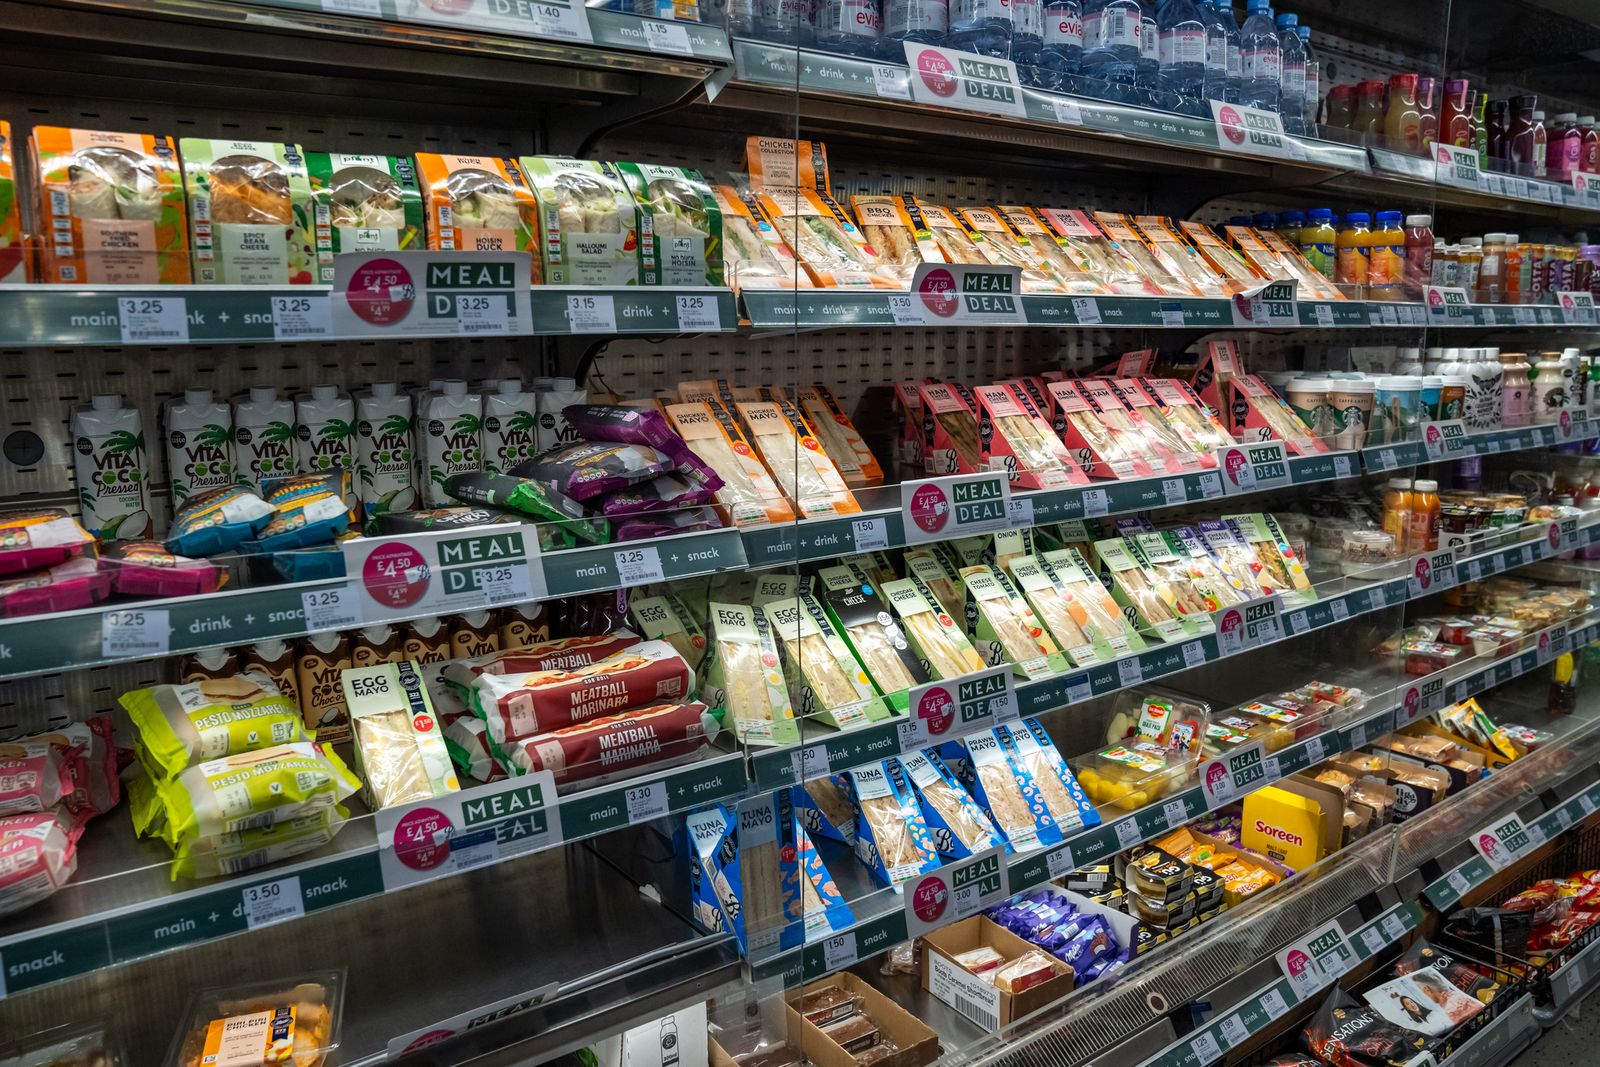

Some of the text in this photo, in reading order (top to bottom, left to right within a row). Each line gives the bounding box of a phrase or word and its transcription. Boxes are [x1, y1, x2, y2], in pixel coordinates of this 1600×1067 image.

[537, 7, 560, 18] 1.40
[648, 23, 667, 34] 1.15
[771, 61, 845, 80] main drink
[963, 64, 1009, 83] MEAL
[969, 83, 1014, 102] DEAL
[1133, 119, 1206, 138] main drink snack
[1246, 112, 1277, 130] MEAL
[759, 140, 794, 150] CHICKEN
[1251, 131, 1281, 147] DEAL
[760, 148, 795, 157] COLLECTION
[1455, 153, 1475, 167] MEAL
[867, 207, 891, 217] BBQ
[1012, 215, 1031, 224] BBQ
[476, 237, 503, 245] HOISIN
[477, 243, 503, 251] DUCK
[433, 265, 512, 286] MEAL
[966, 276, 1012, 293] MEAL
[1263, 285, 1292, 300] MEAL
[971, 297, 1015, 314] DEAL
[1445, 292, 1465, 305] MEAL
[71, 311, 118, 327] main
[622, 305, 654, 319] drink
[774, 305, 892, 317] main drink snack
[1041, 307, 1060, 317] main
[1104, 307, 1123, 318] snack
[1204, 310, 1220, 319] snack
[927, 388, 949, 397] HAM
[984, 391, 1006, 400] HAM
[1055, 389, 1075, 398] HAM
[1092, 390, 1110, 399] HAM
[677, 412, 707, 420] CHICKEN
[747, 408, 776, 416] CHICKEN
[750, 412, 779, 421] MAYO
[679, 416, 710, 425] MAYO
[498, 429, 532, 446] VITA
[1442, 425, 1463, 438] MEAL
[310, 438, 347, 456] VITA
[370, 433, 407, 450] VITA
[443, 432, 478, 449] VITA
[185, 444, 225, 462] VITA
[251, 441, 290, 459] VITA
[370, 449, 411, 464] COCO
[442, 448, 482, 463] COCO
[497, 444, 536, 459] COCO
[1250, 448, 1281, 463] MEAL
[92, 451, 136, 470] VITA
[185, 461, 230, 476] COCO
[251, 458, 294, 474] COCO
[309, 454, 353, 470] COCO
[374, 460, 409, 475] Pressed
[92, 468, 140, 484] COCO
[1256, 464, 1285, 480] DEAL
[189, 473, 230, 491] Pressed
[97, 482, 140, 500] Pressed
[955, 481, 1001, 500] MEAL
[1141, 491, 1158, 501] main
[960, 502, 1004, 522] DEAL
[1032, 500, 1081, 516] main drink
[442, 535, 521, 563] MEAL
[766, 533, 839, 554] main drink
[576, 547, 720, 577] main snack
[1050, 558, 1069, 568] CHEESE
[1149, 551, 1170, 559] SALAD
[1432, 554, 1452, 568] MEAL
[1015, 565, 1036, 575] CHEESE
[1018, 570, 1040, 579] ONION
[1054, 562, 1074, 571] ONION
[760, 582, 787, 592] EGG
[843, 594, 866, 607] CHEESE
[893, 592, 918, 602] CHEESE
[640, 606, 664, 619] EGG
[644, 612, 668, 624] MAYO
[718, 609, 745, 621] EGG
[774, 607, 798, 619] EGG
[778, 614, 804, 625] CRESS
[1246, 602, 1275, 622] MEAL
[189, 615, 232, 634] drink
[720, 617, 747, 627] MAYO
[466, 641, 496, 657] VITA
[541, 653, 593, 672] MEATBALL
[1165, 656, 1181, 668] drink
[352, 675, 387, 691] EGG
[960, 680, 1006, 701] MEAL
[1033, 673, 1113, 705] main snack
[1422, 678, 1443, 695] MEAL
[355, 684, 390, 699] MAYO
[571, 680, 629, 705] MEATBALL
[571, 694, 629, 721] MARINARA
[195, 712, 232, 731] PESTO
[599, 724, 658, 750] MEATBALL
[968, 736, 995, 748] PRAWN
[600, 739, 662, 766] MARINARA
[827, 736, 893, 764] drink snack
[970, 741, 997, 752] MAYO
[905, 756, 926, 769] TUNA
[1231, 752, 1260, 772] MEAL
[212, 771, 251, 790] PESTO
[855, 768, 882, 780] TUNA
[1235, 769, 1263, 787] DEAL
[467, 789, 541, 822] MEAL
[590, 776, 722, 823] main snack
[741, 805, 772, 821] TUNA
[692, 818, 724, 833] TUNA
[742, 813, 772, 831] MAYO
[1497, 820, 1521, 840] MEAL
[695, 825, 725, 841] MAYO
[1256, 819, 1303, 847] Soreen
[1506, 834, 1529, 852] DEAL
[1024, 839, 1105, 881] main snack
[955, 862, 998, 884] MEAL
[305, 877, 349, 899] snack
[9, 918, 197, 978] snack main
[1310, 929, 1340, 956] MEAL
[780, 930, 888, 980] main snack
[1064, 943, 1081, 961] Milka
[226, 1022, 267, 1031] CHICKEN
[1243, 1011, 1258, 1026] drink
[1319, 1012, 1375, 1061] SENSATIONS
